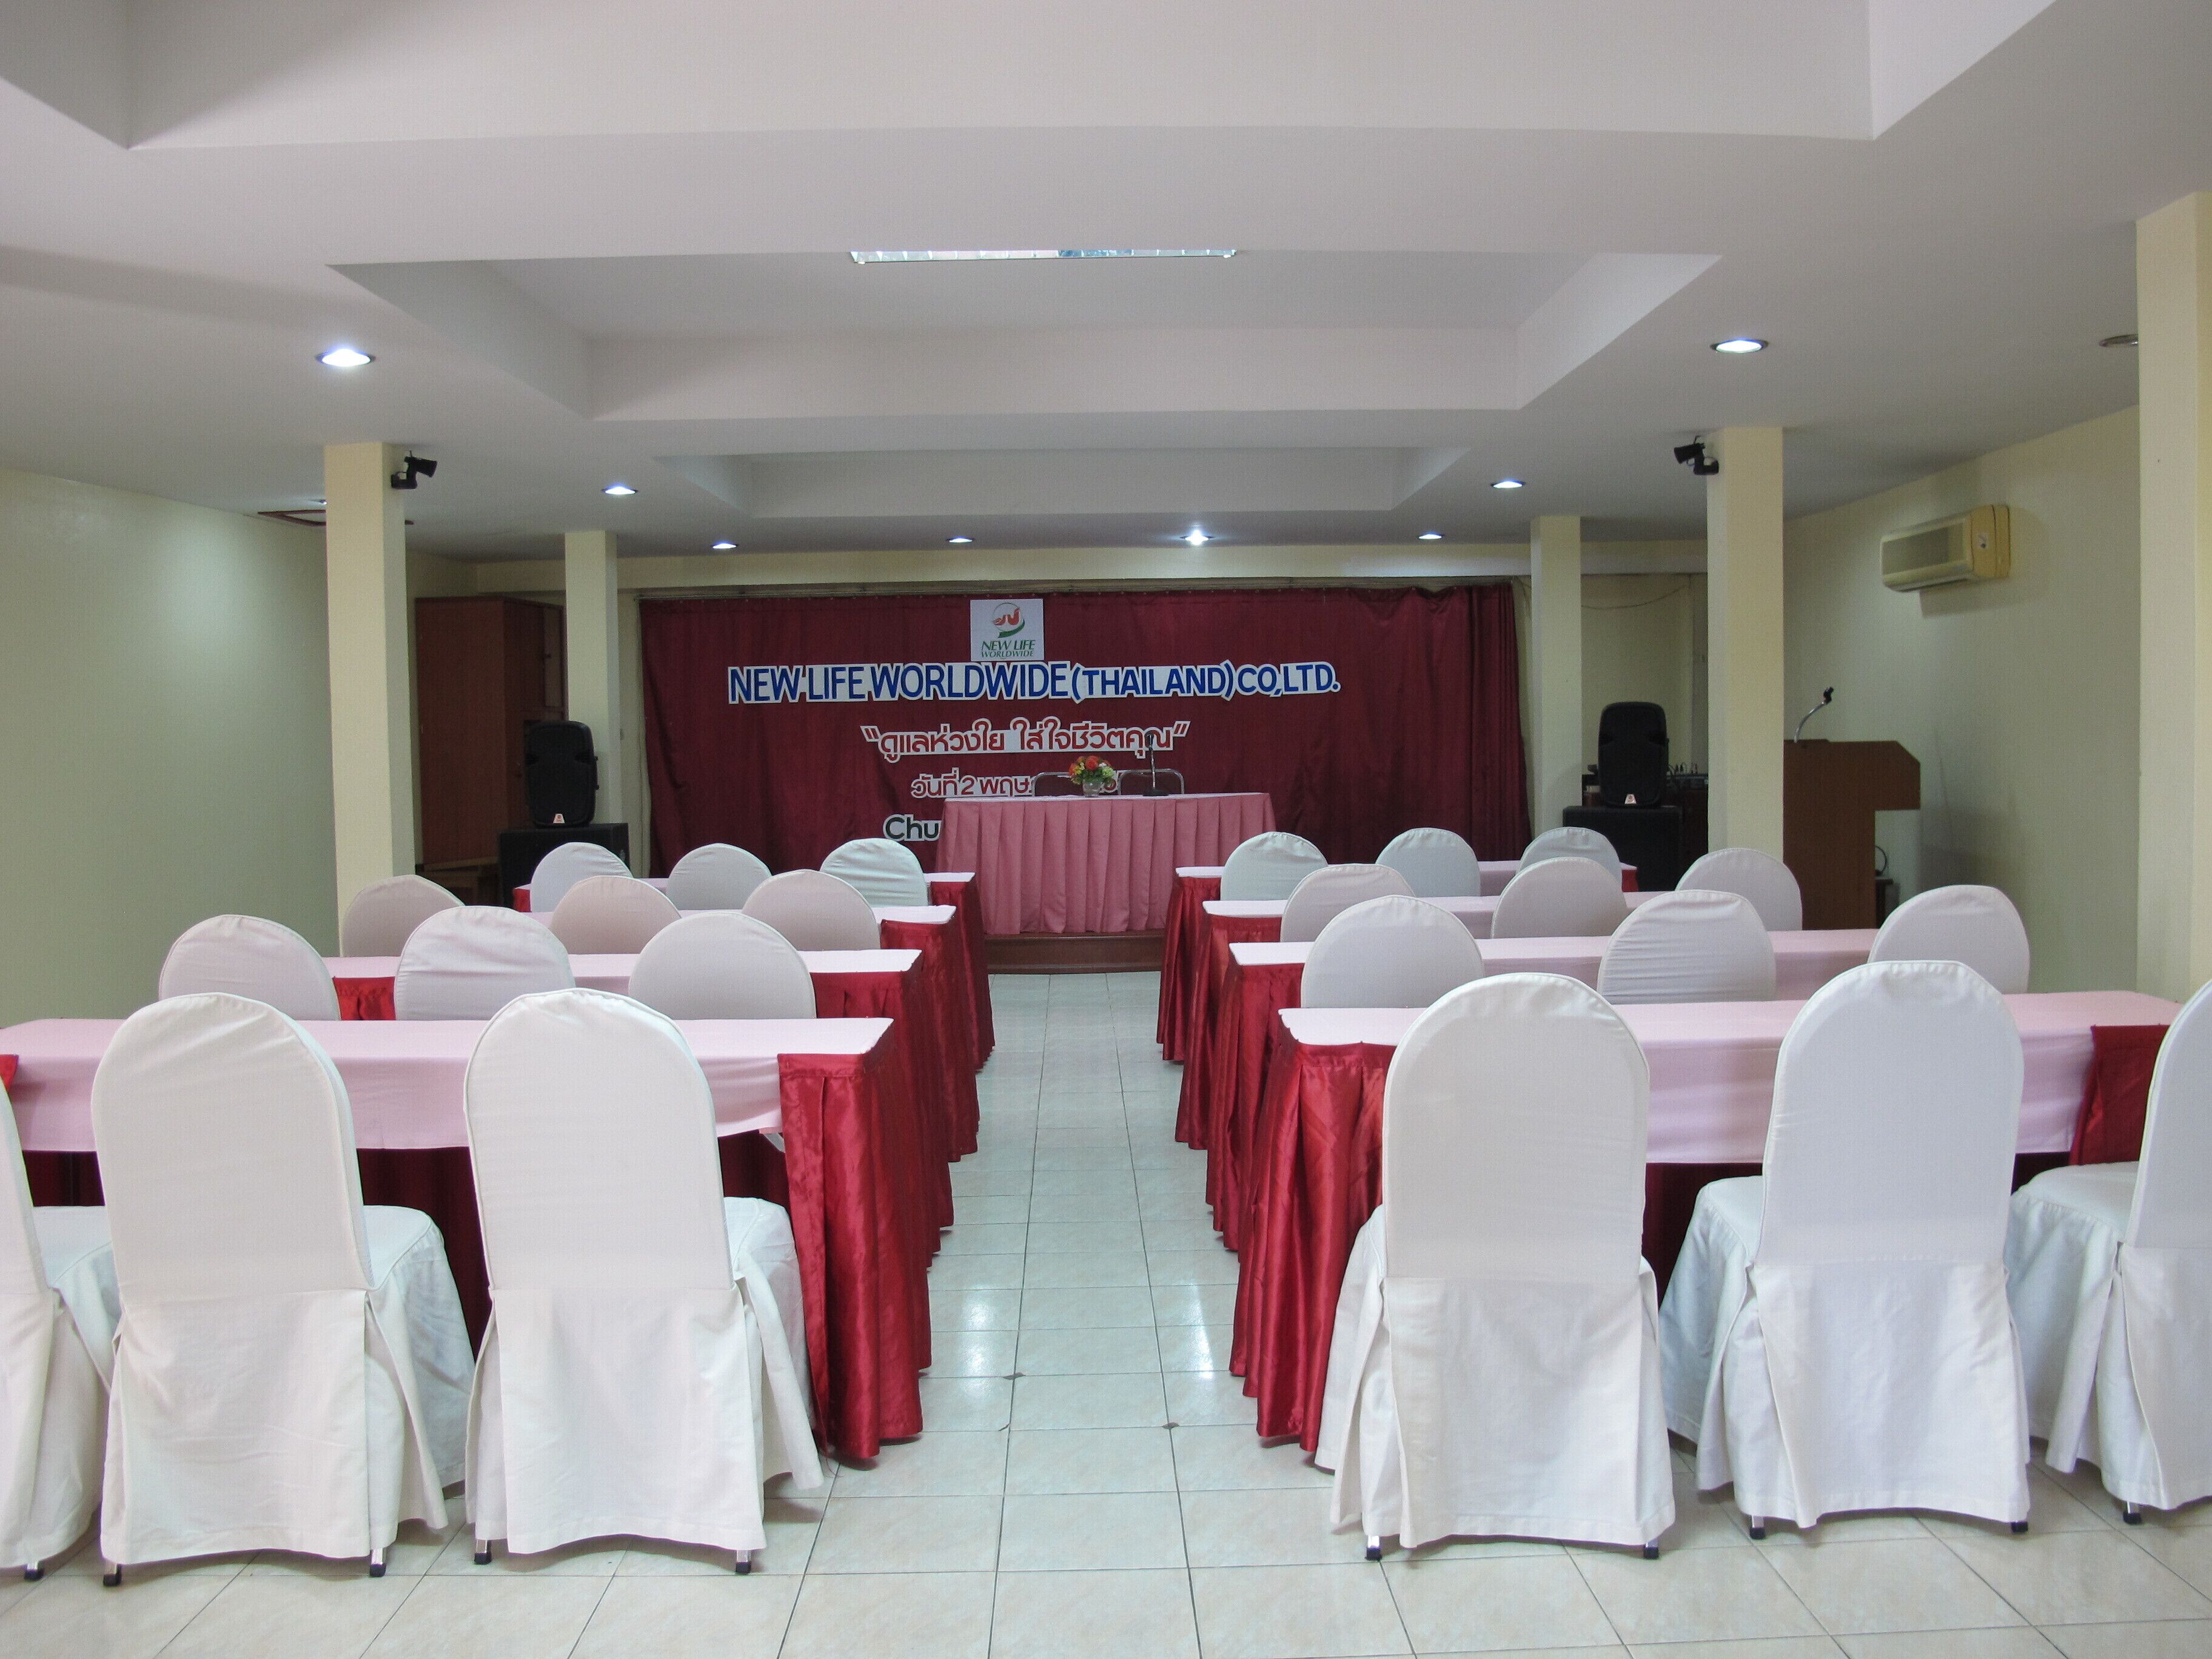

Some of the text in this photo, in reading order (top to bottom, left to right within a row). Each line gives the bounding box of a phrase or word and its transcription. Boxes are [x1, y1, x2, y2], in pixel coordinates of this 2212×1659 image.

[981, 639, 1036, 651] NEW LIFE
[730, 668, 801, 702] NEW
[808, 666, 866, 700] LIFE
[885, 816, 939, 840] Chu
